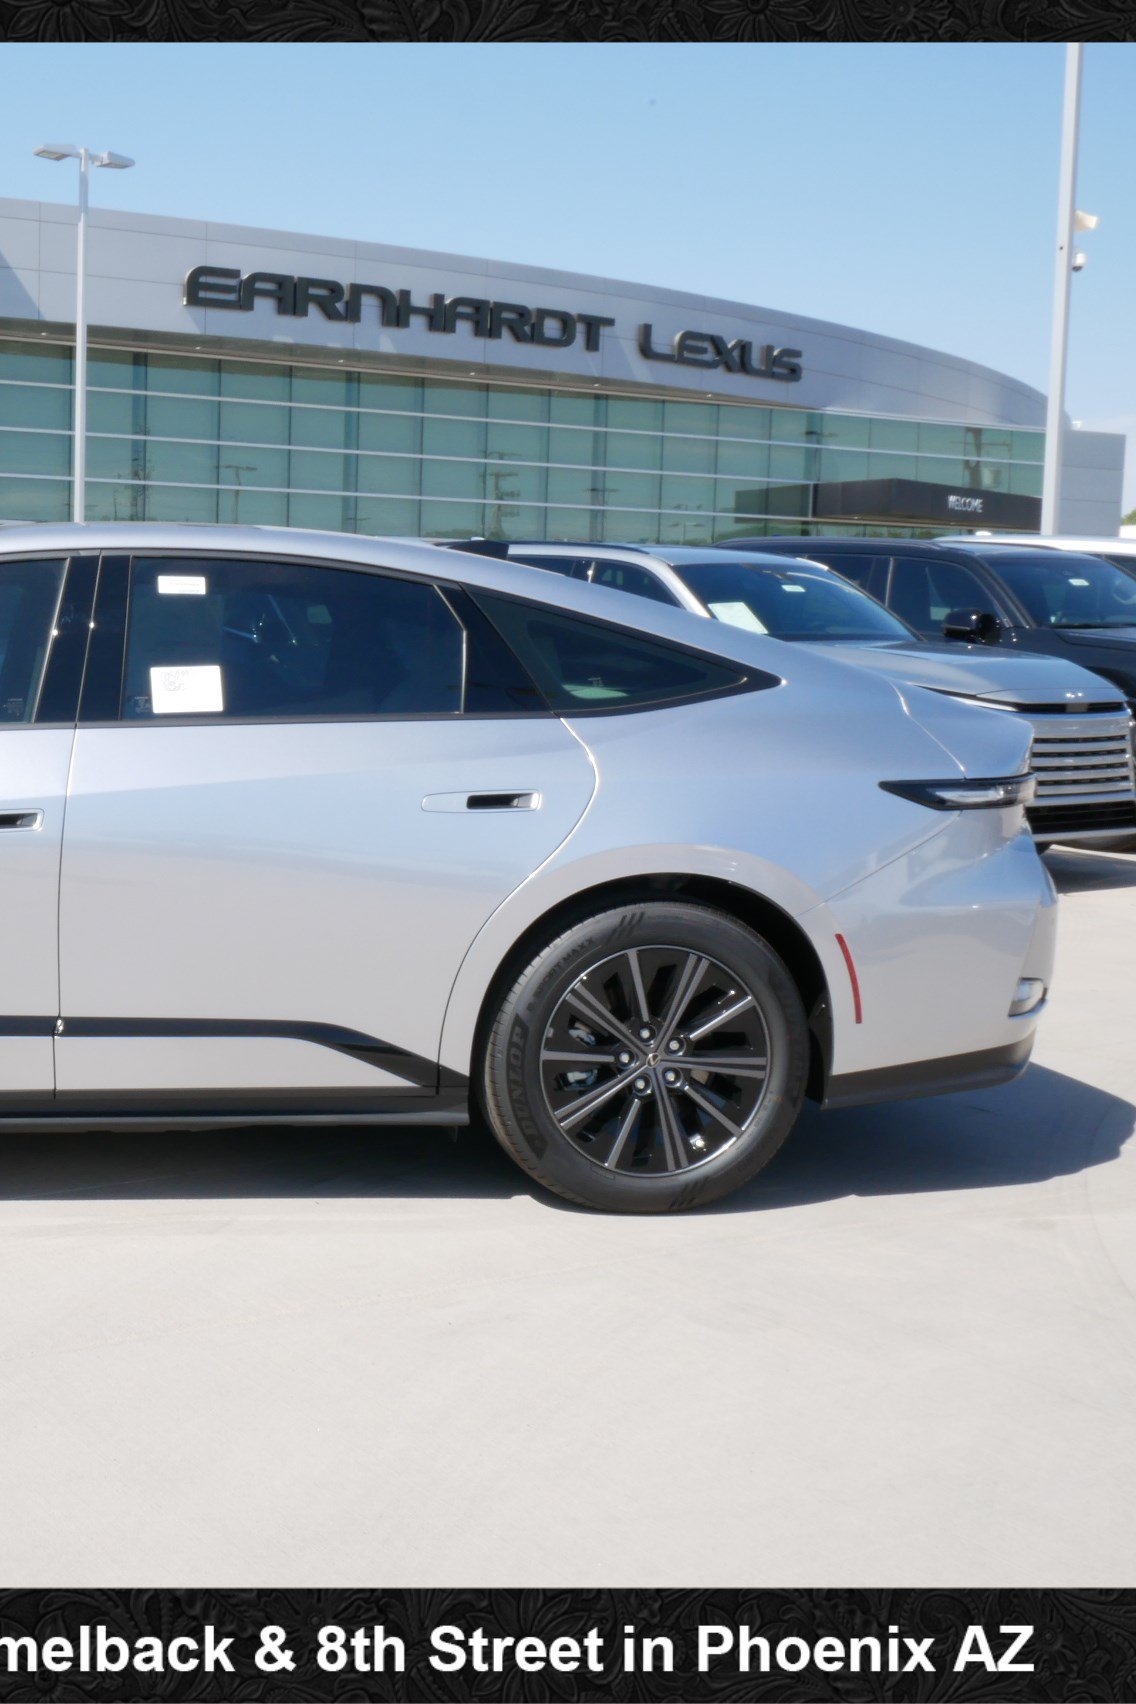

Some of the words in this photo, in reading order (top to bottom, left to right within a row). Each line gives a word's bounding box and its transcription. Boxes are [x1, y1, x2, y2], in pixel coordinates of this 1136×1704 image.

[183, 265, 615, 353] EARNHARDT
[637, 322, 803, 383] LEXUS
[947, 495, 983, 513] WELCOME
[507, 1024, 538, 1137] DUNLOP
